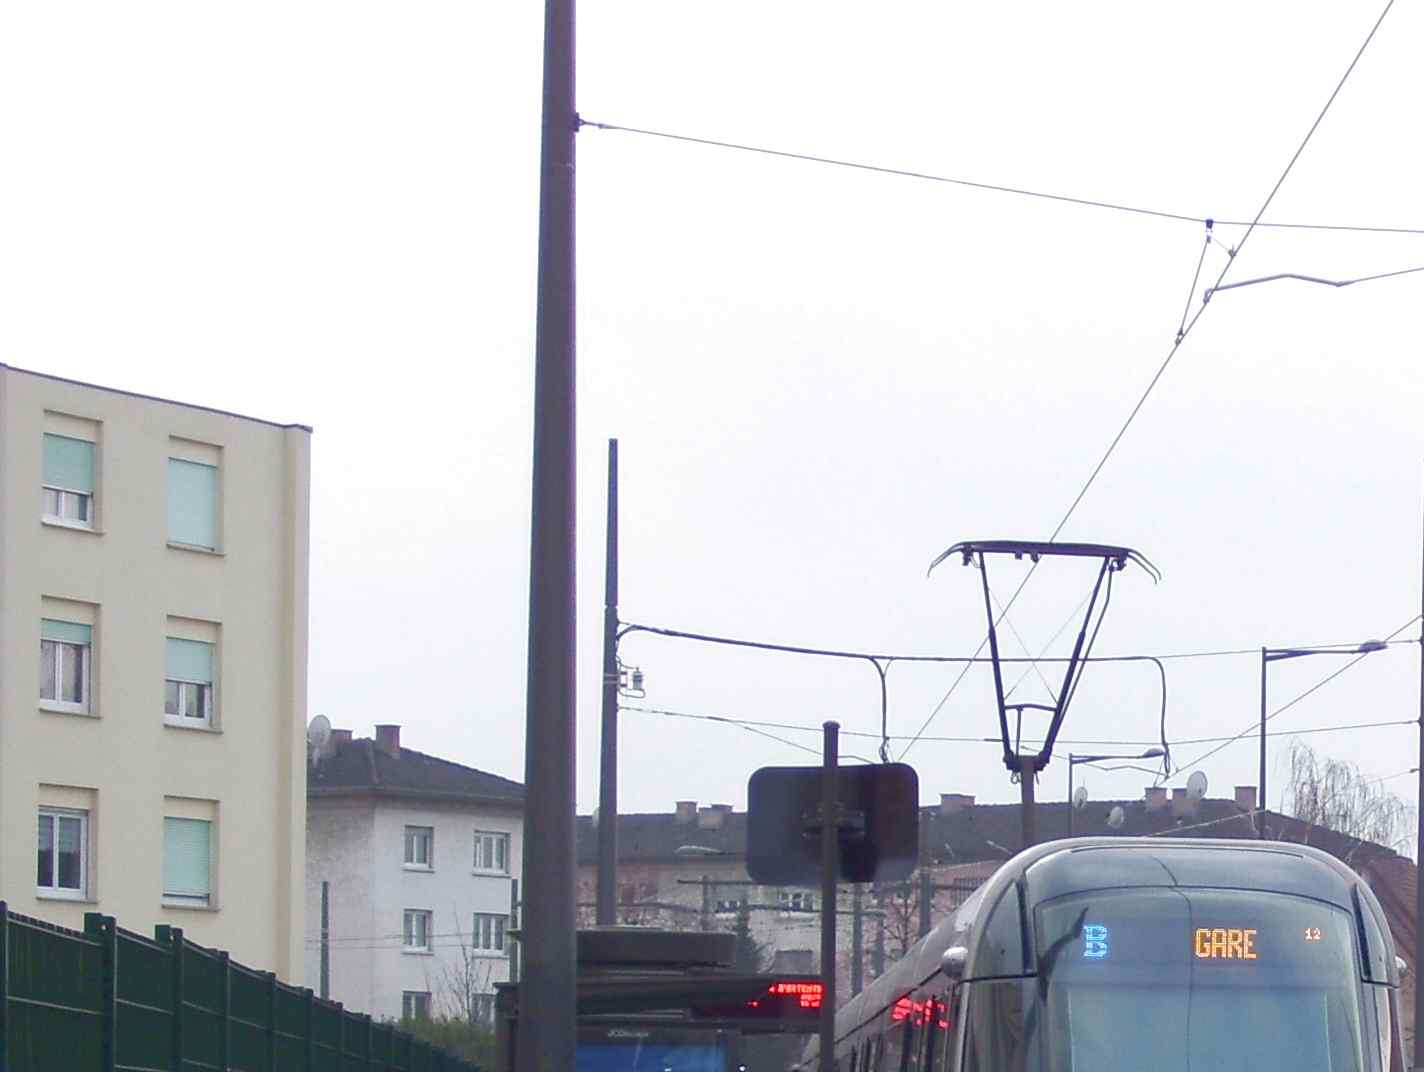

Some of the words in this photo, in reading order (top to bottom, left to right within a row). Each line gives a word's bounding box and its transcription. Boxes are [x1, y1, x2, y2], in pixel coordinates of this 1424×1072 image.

[1082, 925, 1108, 958] B
[1194, 927, 1257, 959] GARE
[1304, 927, 1321, 940] 12
